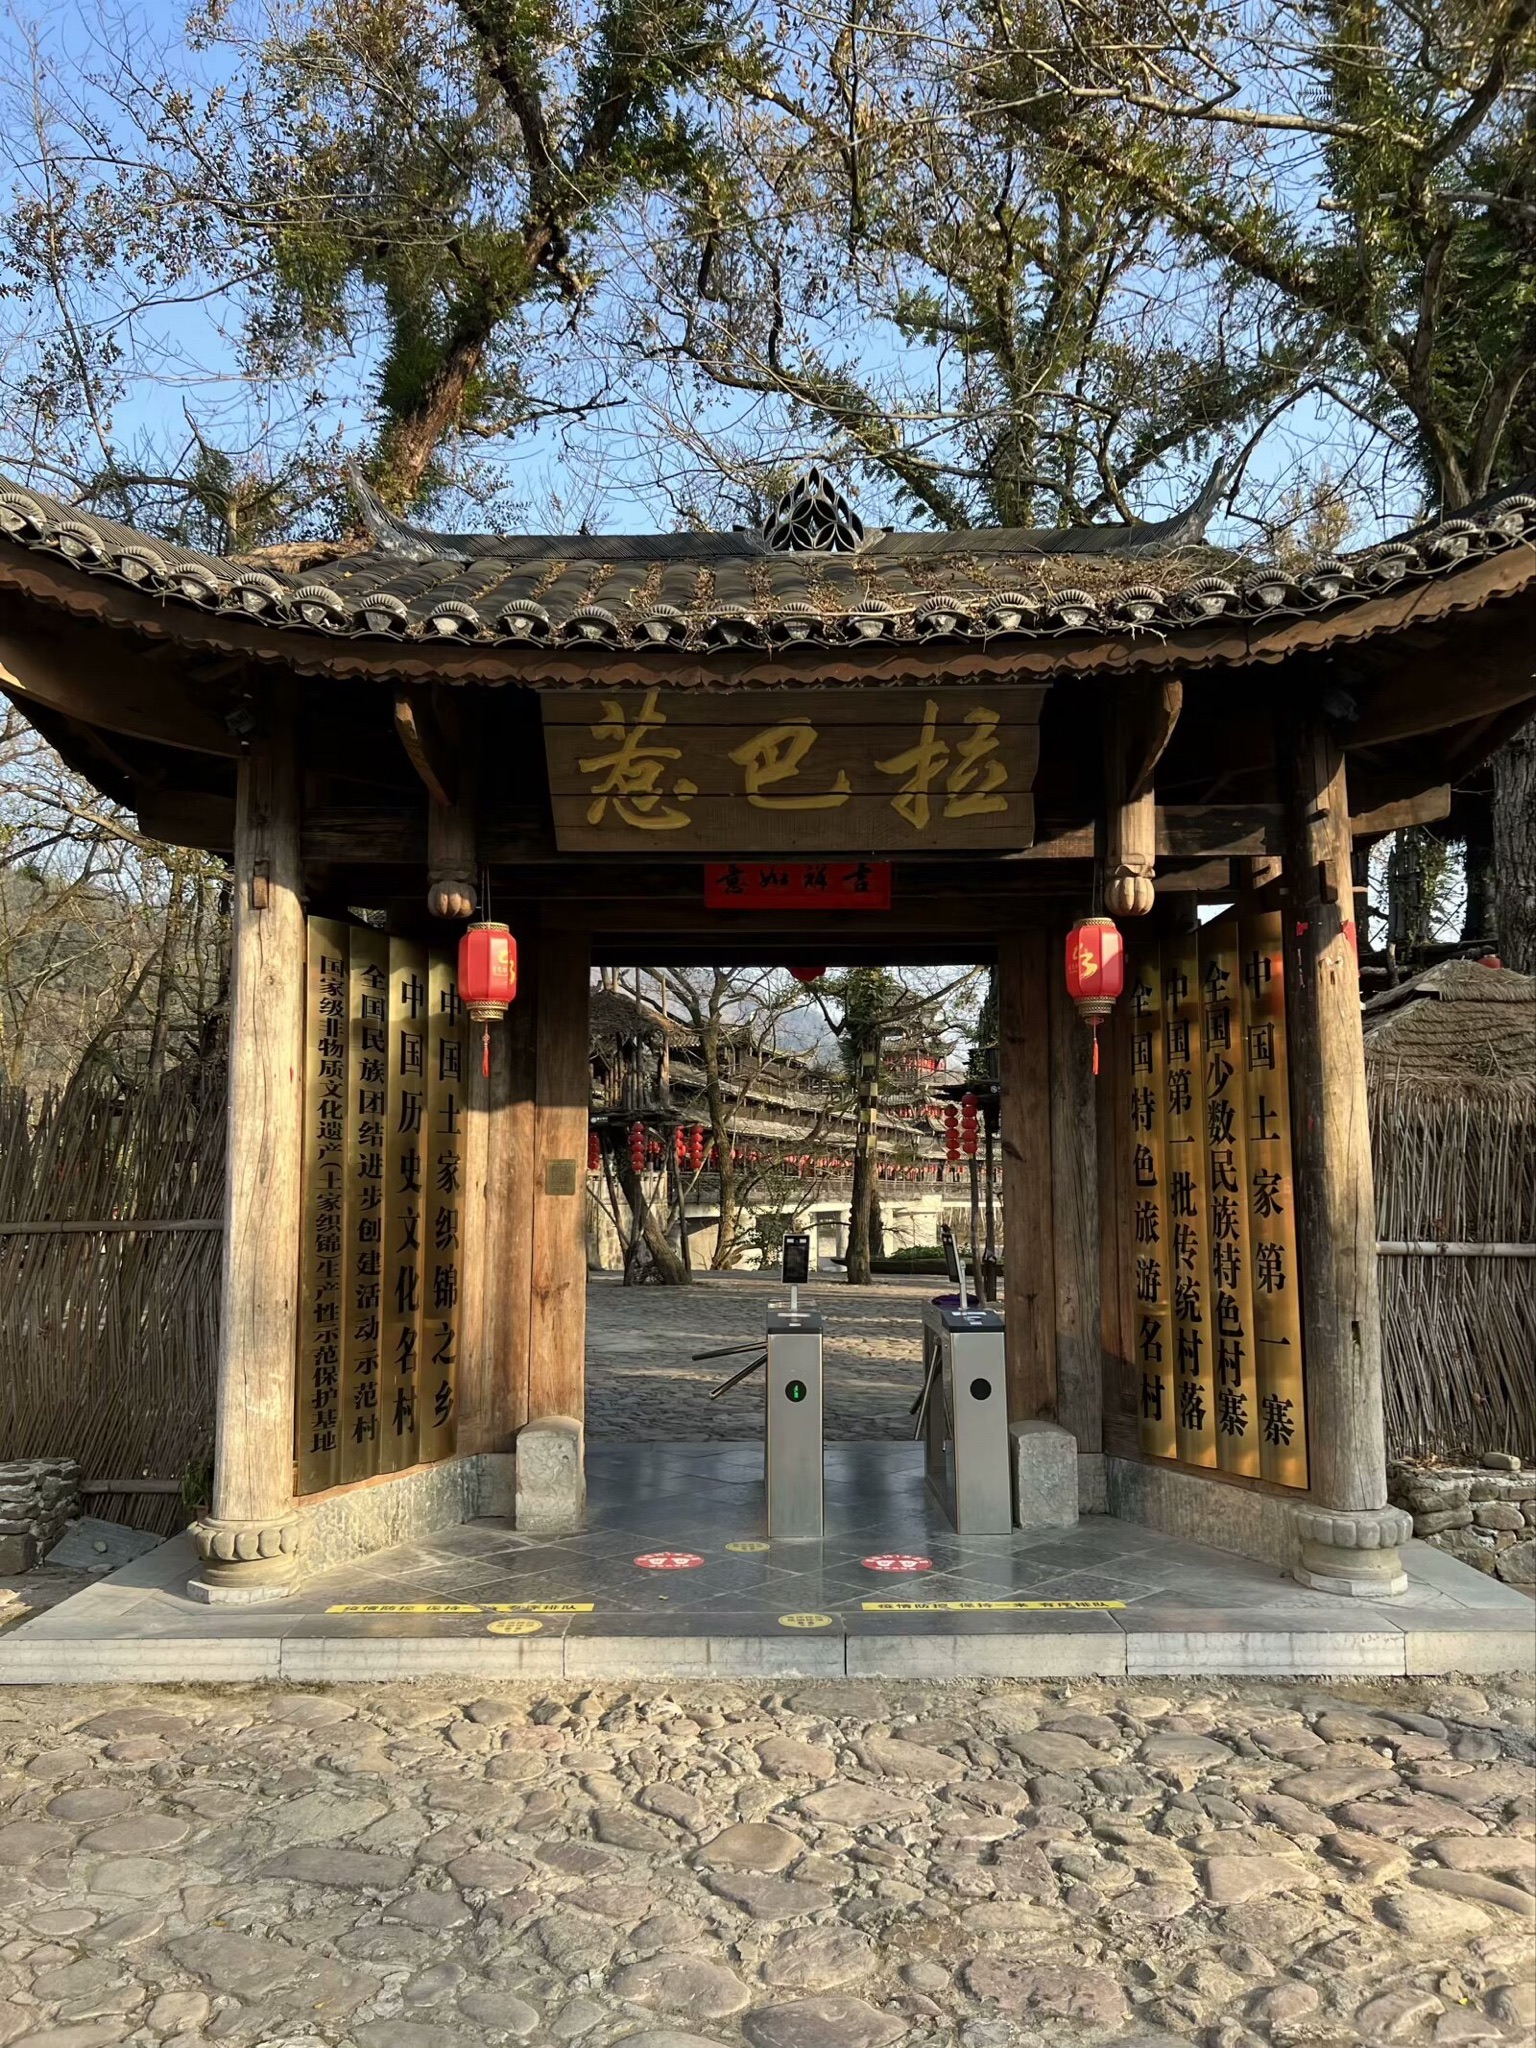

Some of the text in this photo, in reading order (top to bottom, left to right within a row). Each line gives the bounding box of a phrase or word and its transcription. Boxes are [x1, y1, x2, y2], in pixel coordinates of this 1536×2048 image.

[352, 964, 386, 1444] 全国民族团结进步创建活动示范村
[392, 973, 424, 1437] 中国历史文化名村
[432, 982, 462, 1429] 中国土家织锦之乡
[1130, 979, 1165, 1422] 全国特色旅游名村
[1165, 967, 1207, 1431] 中国第一批传统村落
[1204, 960, 1249, 1437] 全国少数民族特色村寨
[1244, 950, 1295, 1447] 中国土家第一寨
